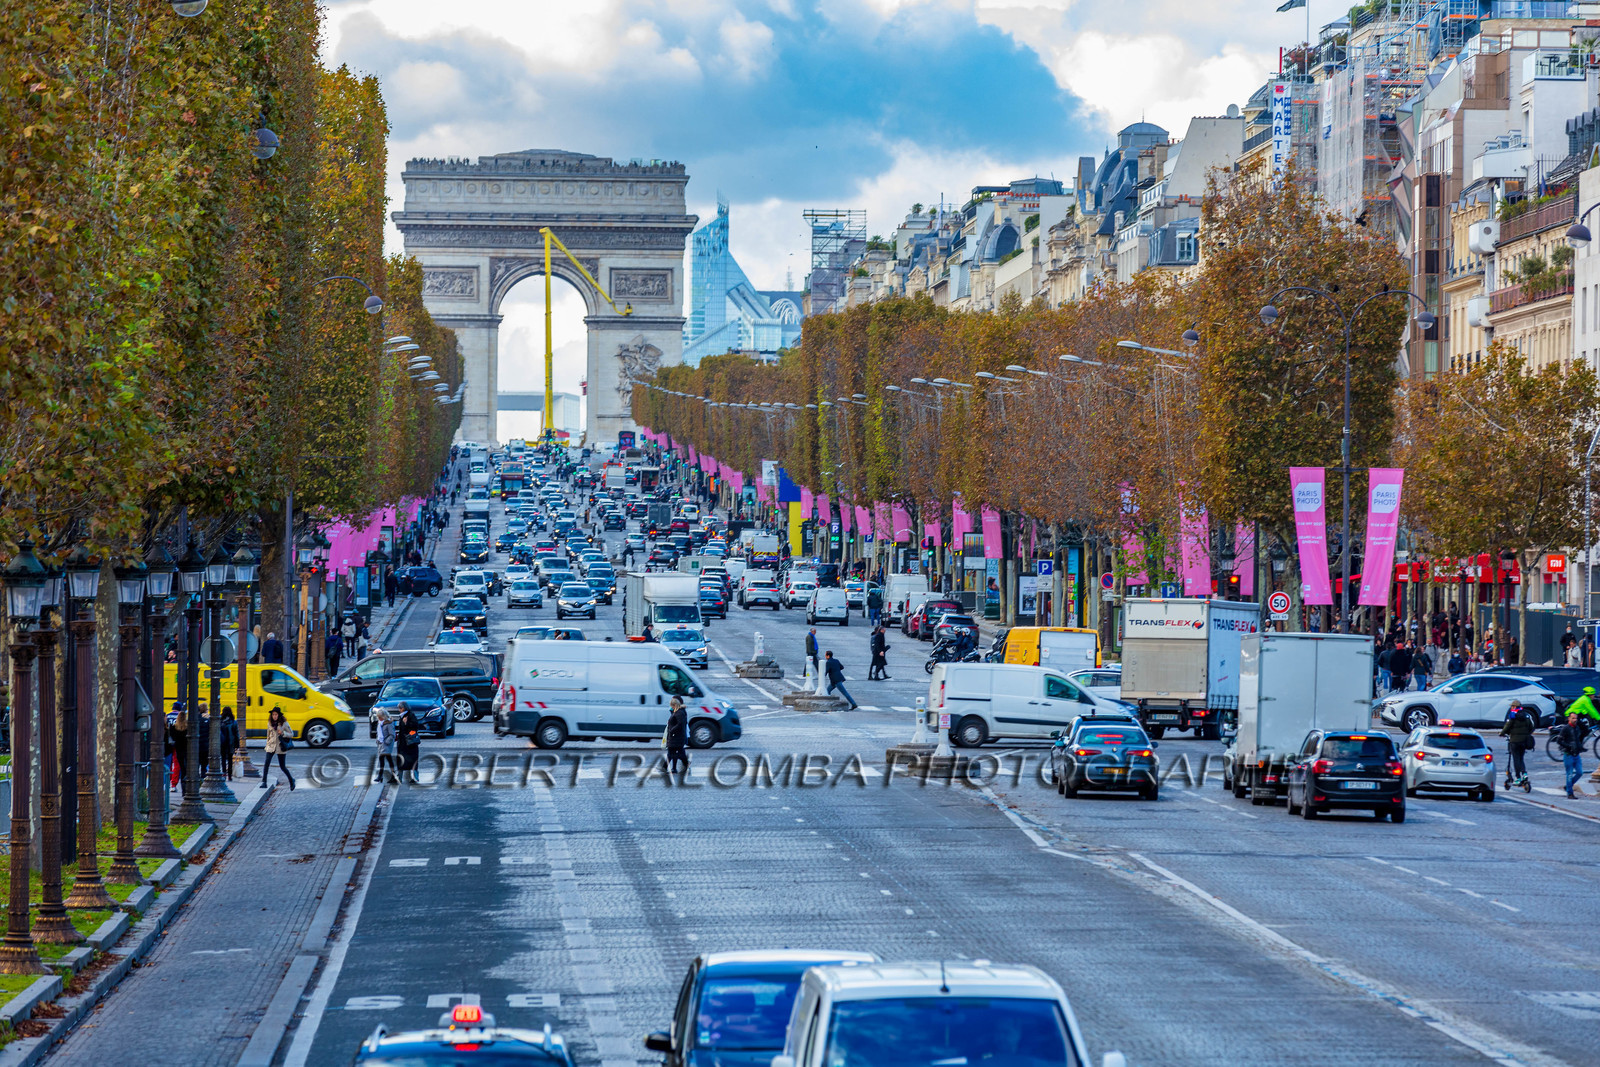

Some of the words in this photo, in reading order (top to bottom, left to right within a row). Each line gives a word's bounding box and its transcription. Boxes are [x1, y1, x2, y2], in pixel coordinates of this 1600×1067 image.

[1376, 491, 1396, 499] PARIS
[1296, 497, 1320, 505] PHOTO
[1273, 598, 1286, 608] 50
[1128, 619, 1192, 627] TRANSFLEX
[1213, 618, 1250, 632] TRANSFLEX
